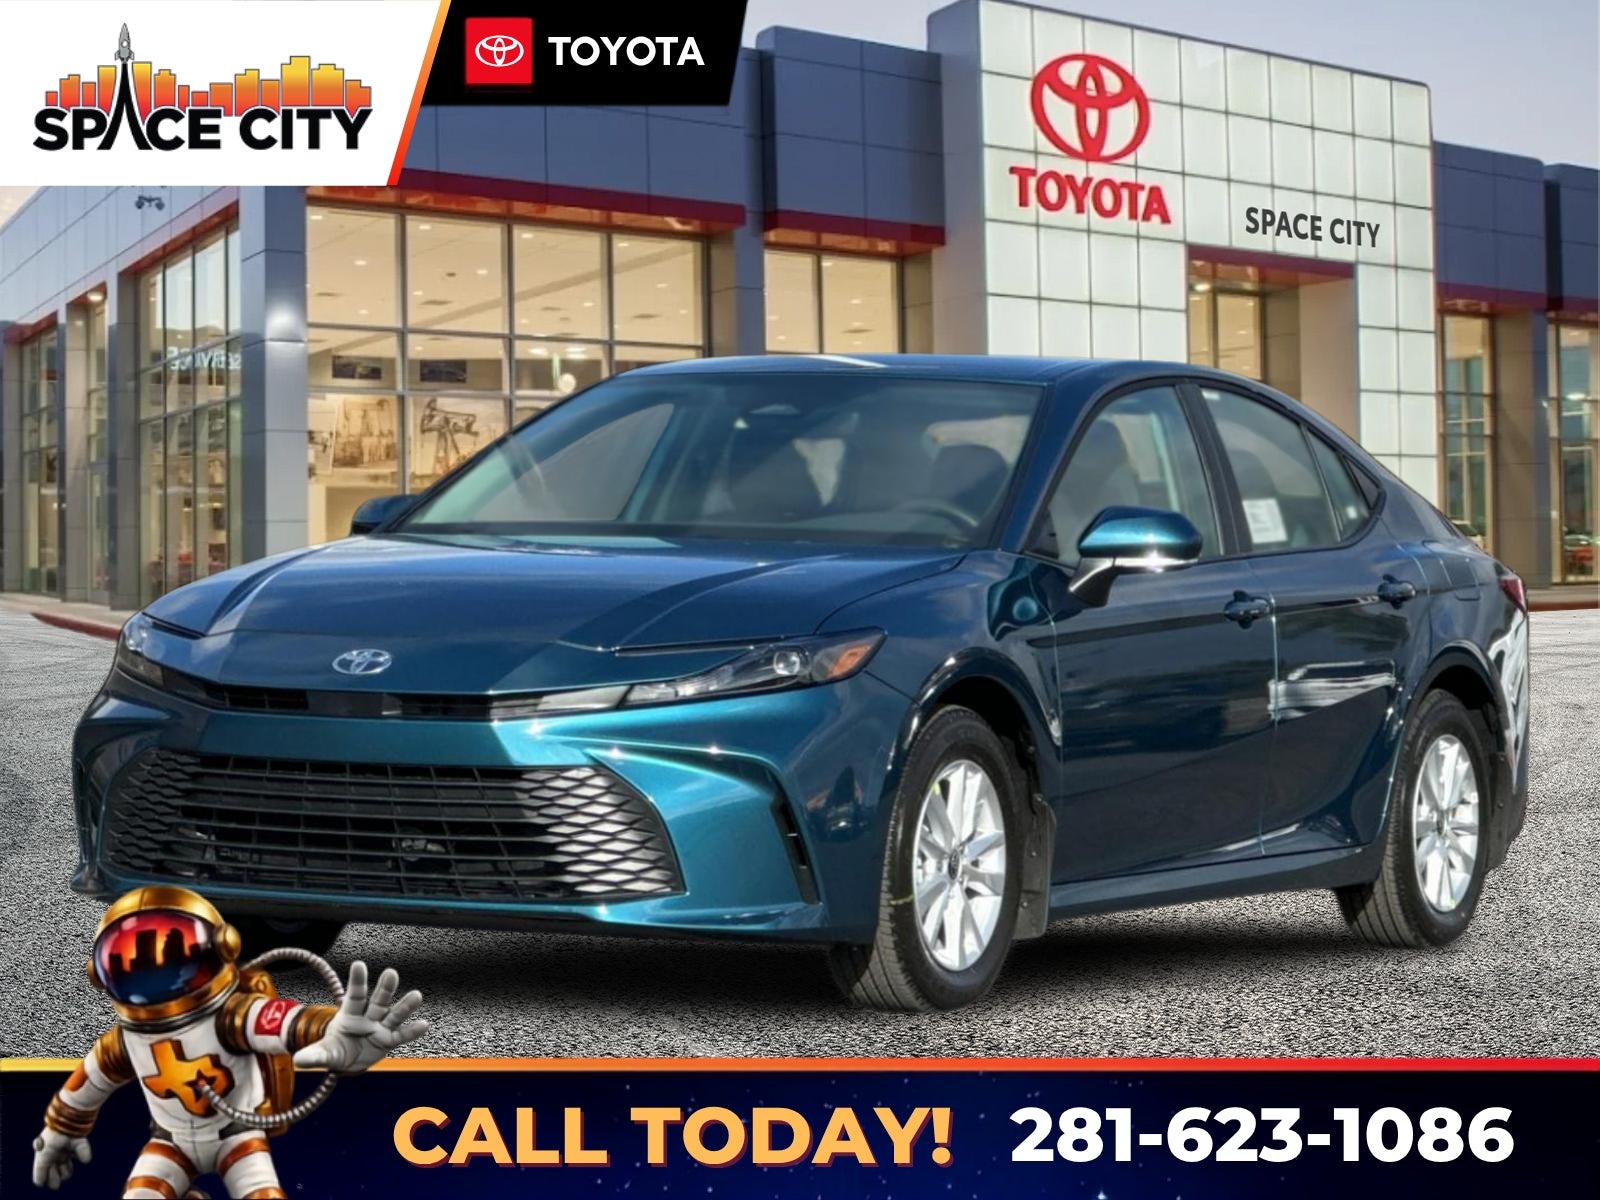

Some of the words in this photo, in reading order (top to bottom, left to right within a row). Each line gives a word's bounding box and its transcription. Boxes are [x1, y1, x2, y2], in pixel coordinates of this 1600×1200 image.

[1009, 165, 1171, 224] TOYOTA
[1245, 206, 1323, 242] SPACE
[1329, 217, 1381, 248] CITY
